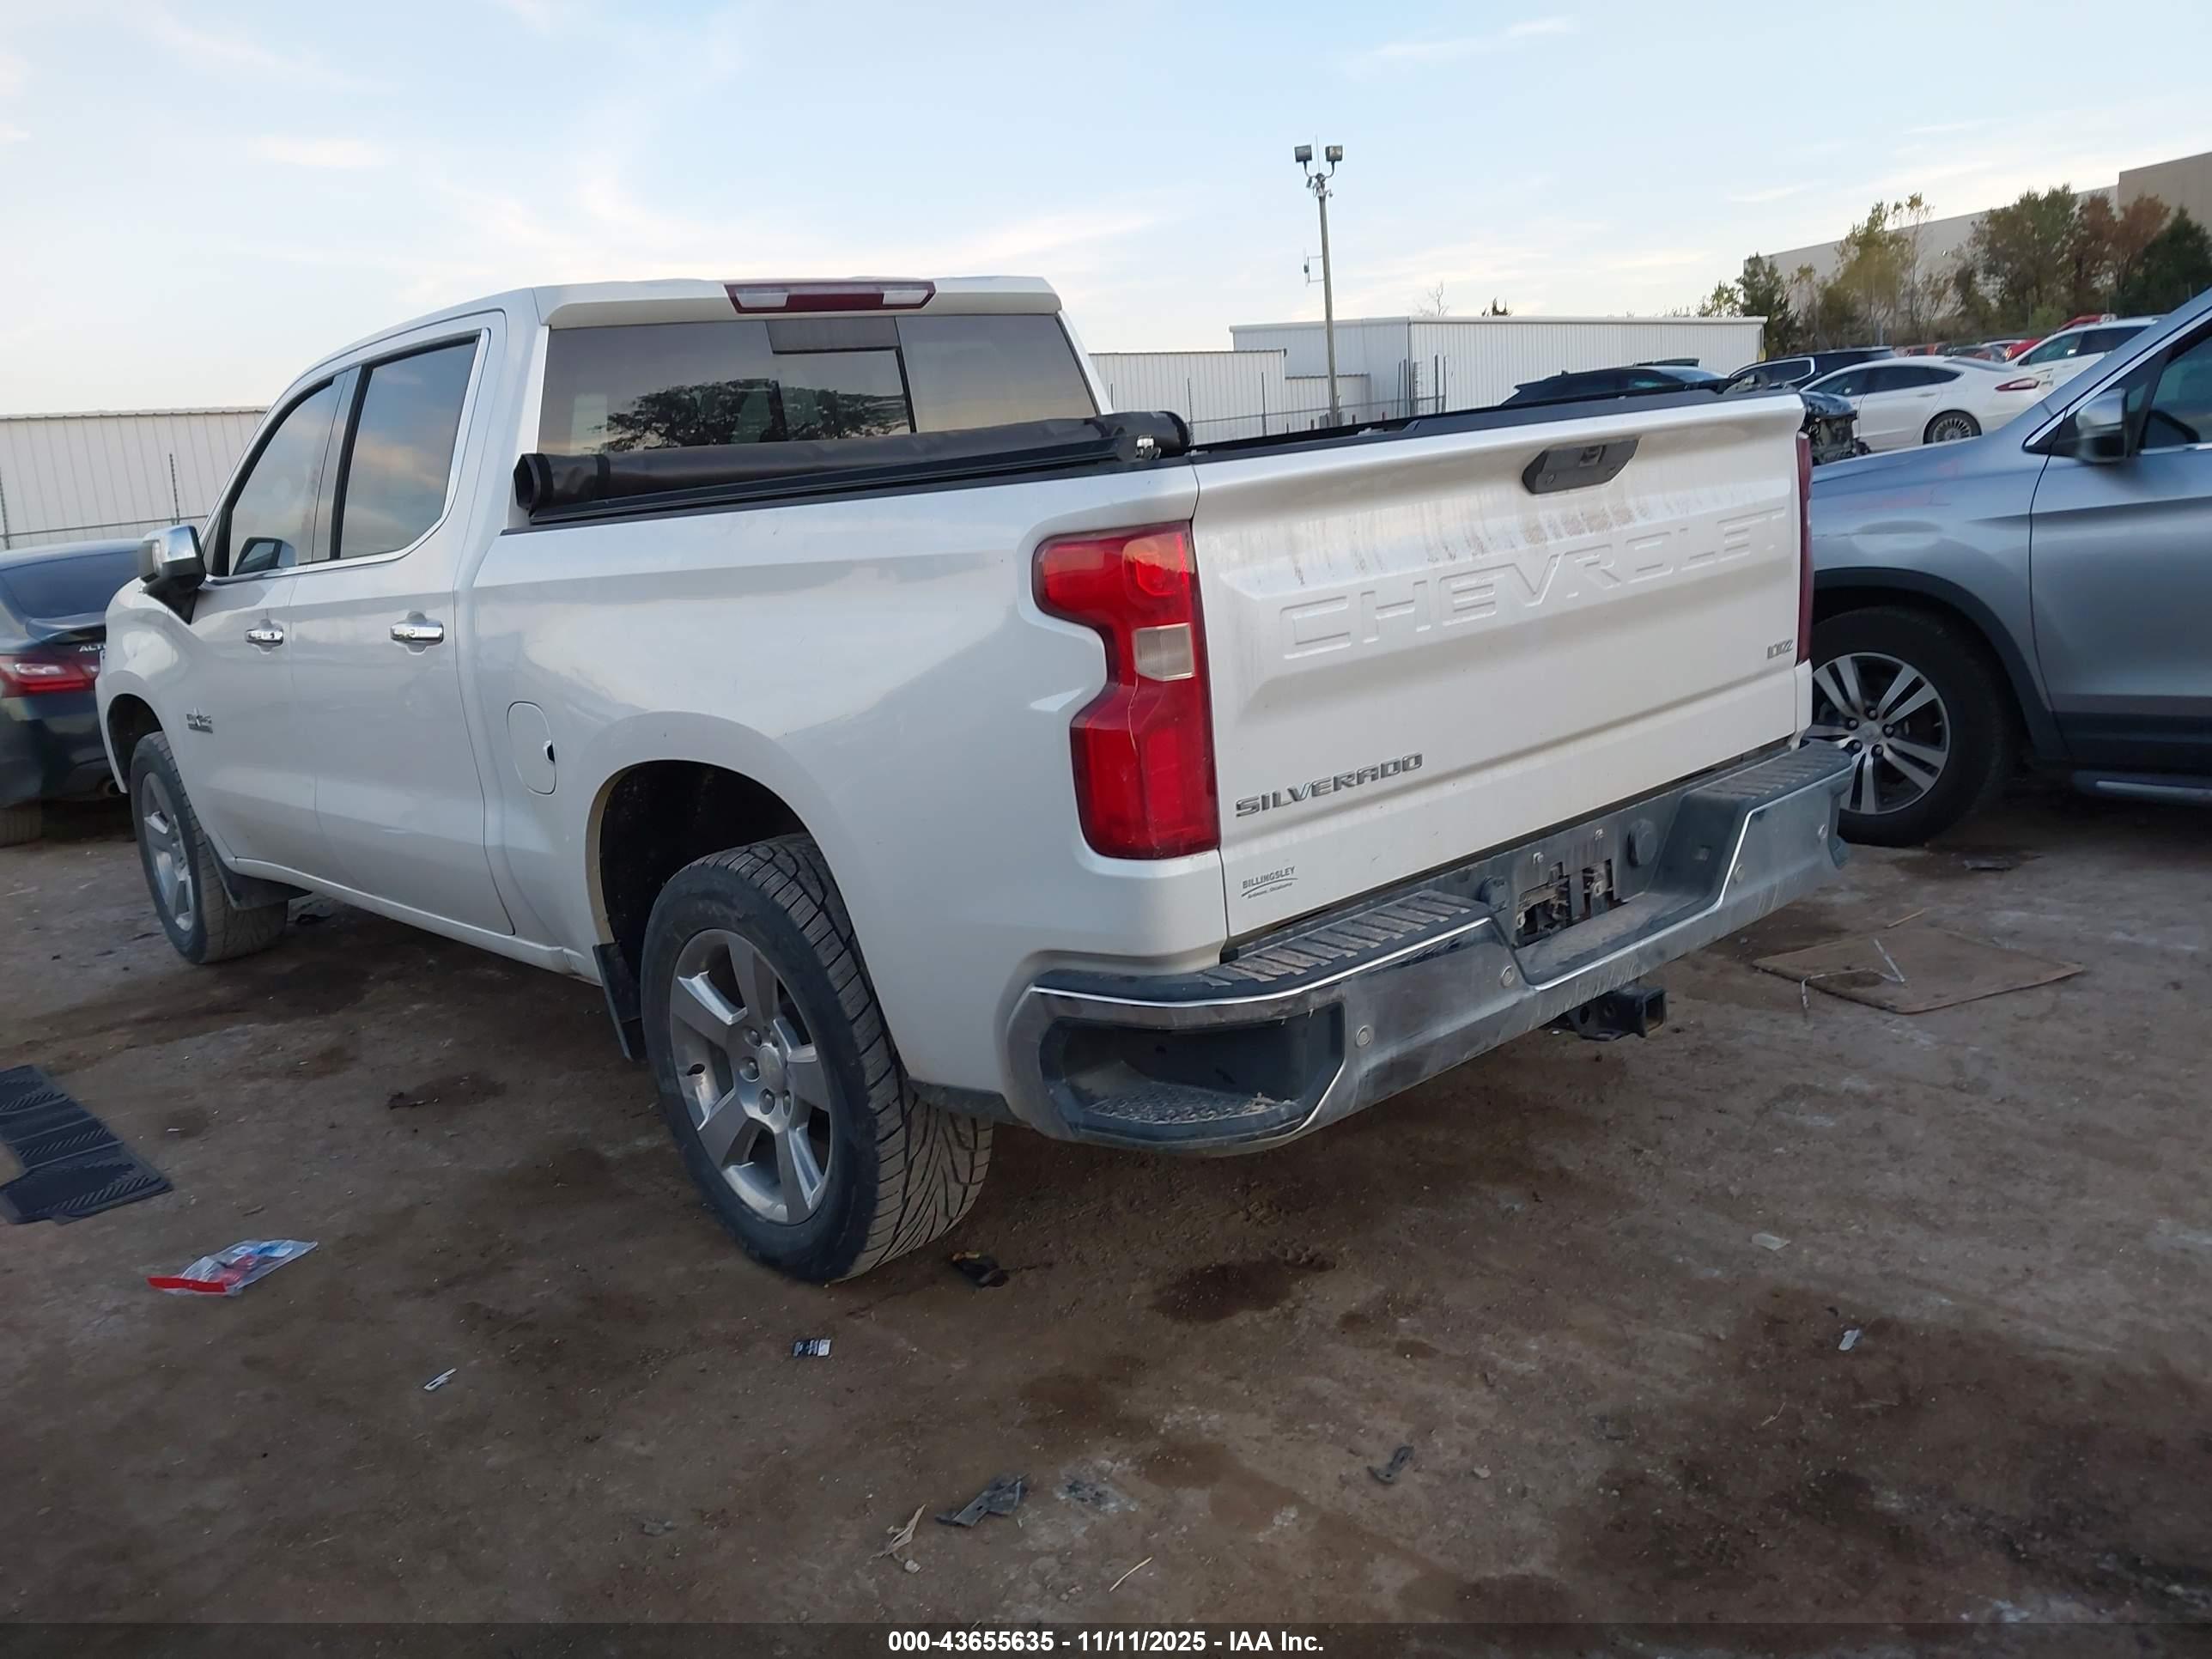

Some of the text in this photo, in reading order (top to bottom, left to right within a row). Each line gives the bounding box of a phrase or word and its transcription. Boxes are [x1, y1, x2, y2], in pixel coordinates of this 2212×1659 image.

[1279, 506, 1788, 659] CHEVROLET
[1236, 752, 1423, 817] SILVERADO
[1242, 866, 1296, 889] BILLINGSLEY
